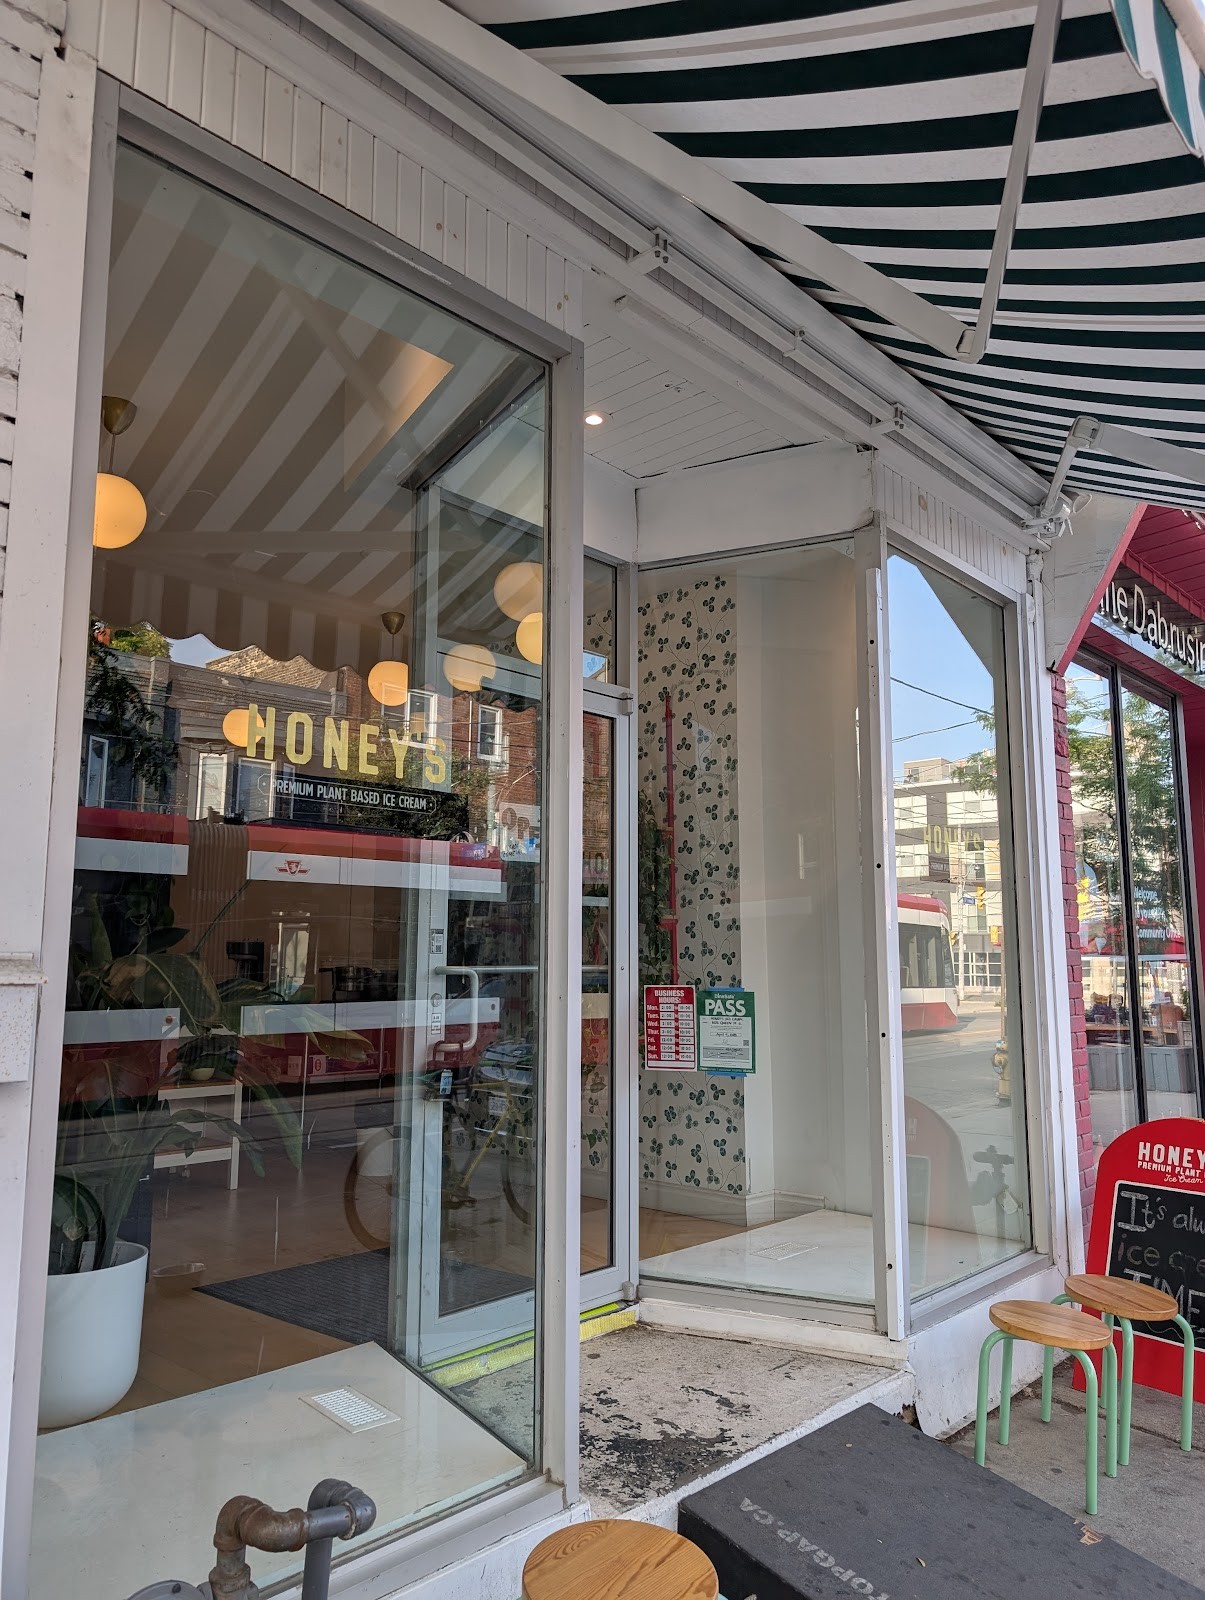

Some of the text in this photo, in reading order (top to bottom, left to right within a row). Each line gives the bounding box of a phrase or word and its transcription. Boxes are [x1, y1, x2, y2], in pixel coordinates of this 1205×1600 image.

[246, 703, 447, 784] HONEY'S
[273, 779, 427, 810] PREMIUM PLANT BASED ICE CREAM
[654, 989, 685, 997] BUSINESS
[704, 999, 746, 1017] PASS
[1137, 1161, 1172, 1173] PREMIUM
[1175, 1166, 1202, 1178] PLANT
[1138, 1141, 1205, 1170] HONEY
[1164, 1174, 1177, 1182] Ice
[1178, 1174, 1204, 1184] Cream
[1117, 1190, 1168, 1233] It's
[1117, 1233, 1161, 1267] ice
